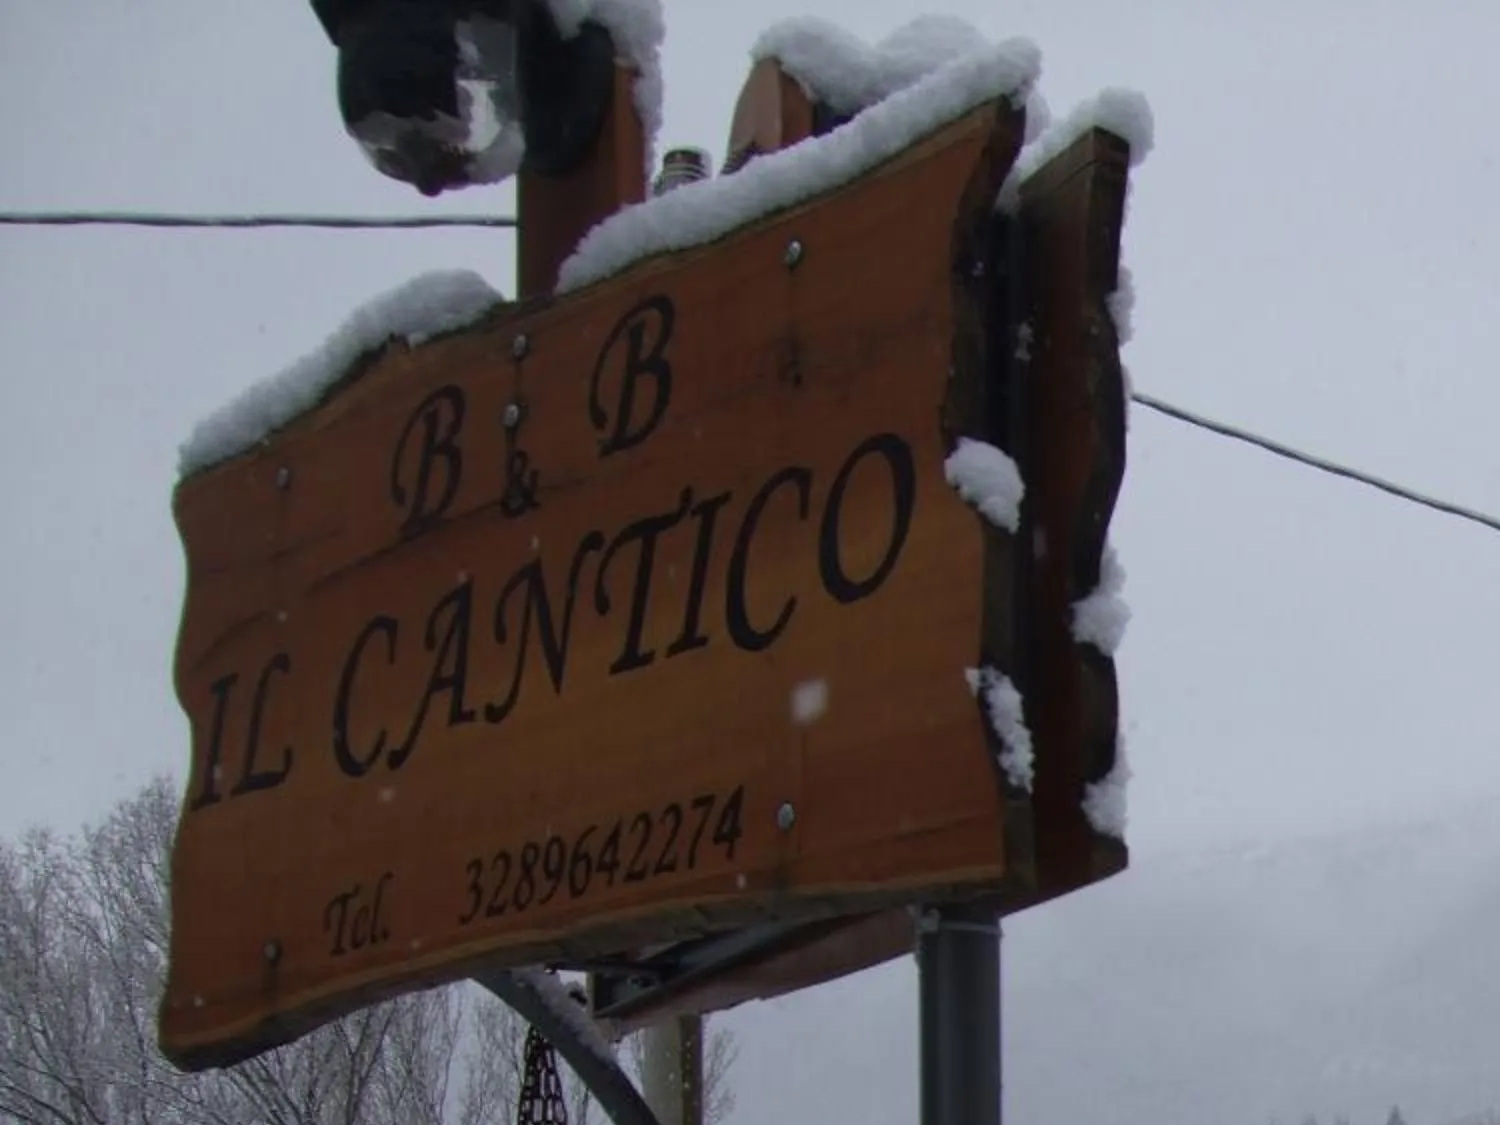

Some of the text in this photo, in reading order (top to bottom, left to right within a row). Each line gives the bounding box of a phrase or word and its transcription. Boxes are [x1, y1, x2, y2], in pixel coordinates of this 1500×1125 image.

[392, 294, 676, 533] B & B
[192, 433, 917, 811] IL CANTICO
[458, 785, 747, 927] 3289642274
